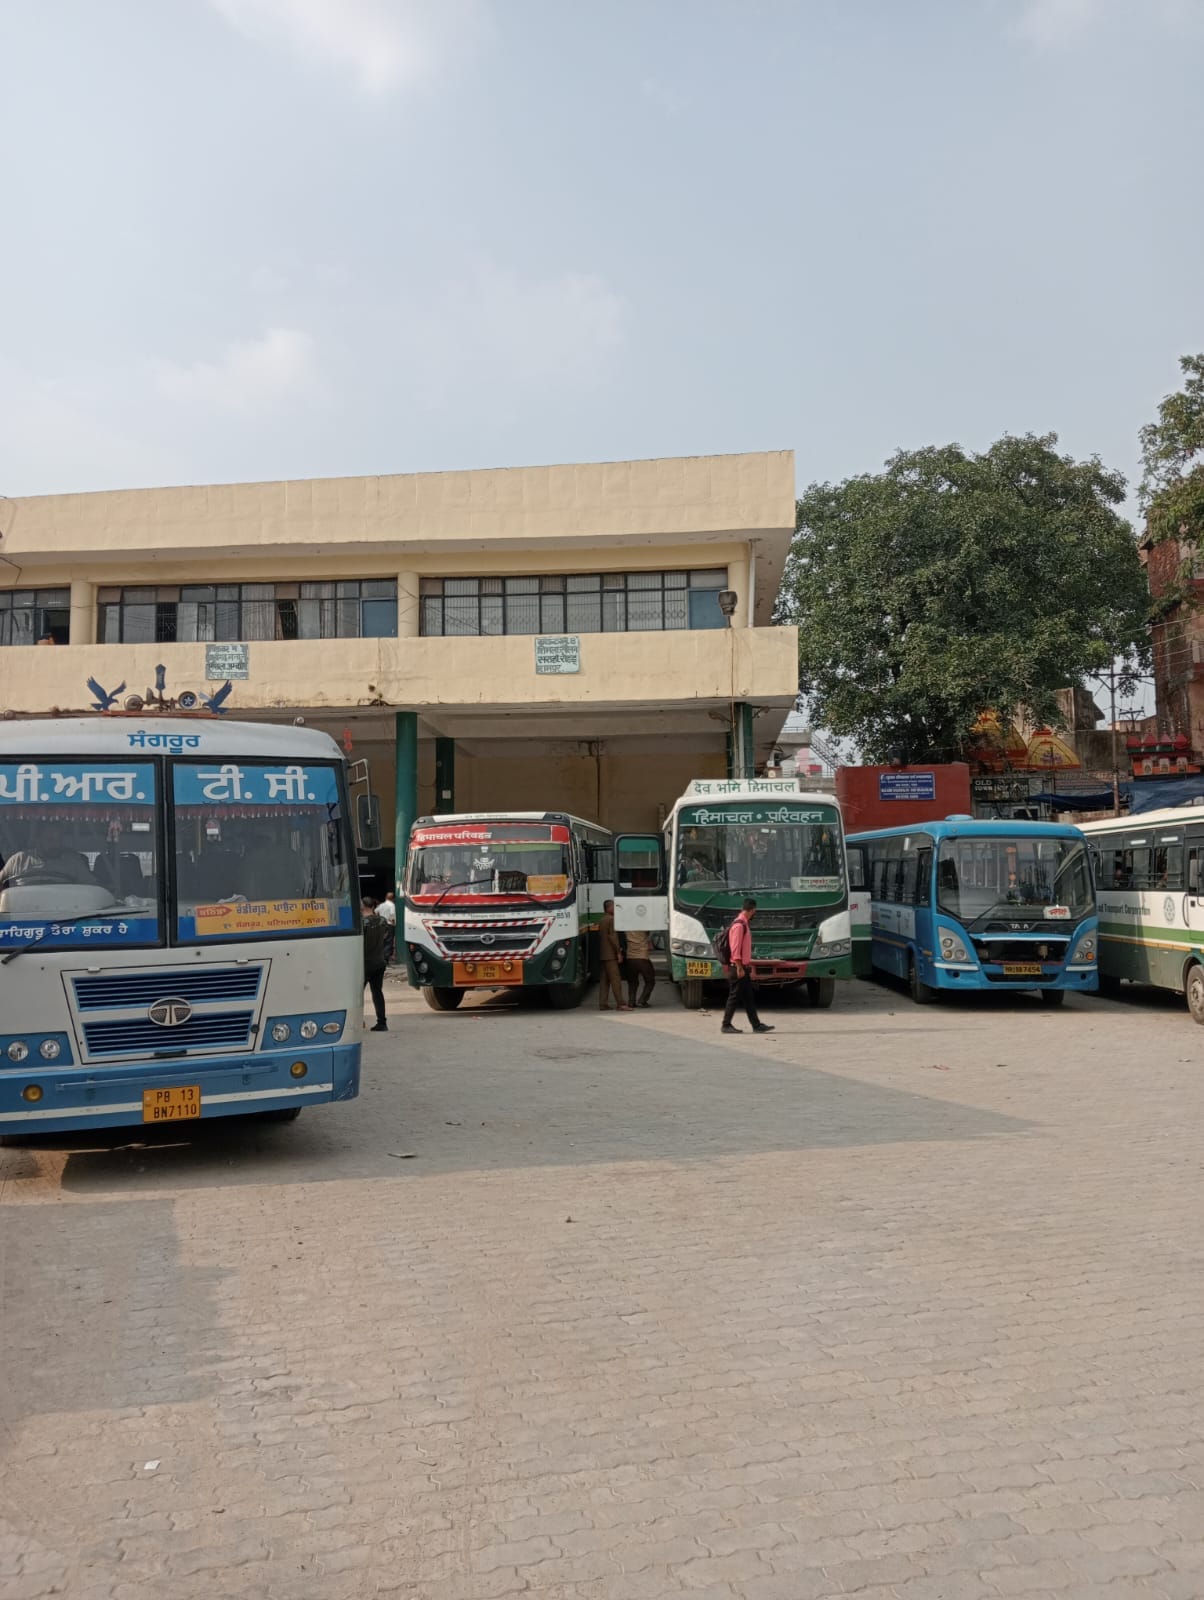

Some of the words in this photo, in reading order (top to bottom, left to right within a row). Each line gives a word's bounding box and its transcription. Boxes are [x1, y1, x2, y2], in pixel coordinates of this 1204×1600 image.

[128, 730, 201, 753] ਸੰਗਰੂਰ
[748, 780, 796, 793] हिमाचल
[692, 809, 754, 825] हिमाचल
[765, 806, 824, 823] परिवहन
[416, 831, 452, 842] हिमाचल
[453, 830, 492, 840] परिवहन
[156, 1091, 170, 1103] PB
[181, 1089, 194, 1101] 13
[153, 1103, 197, 1119] BN7110
